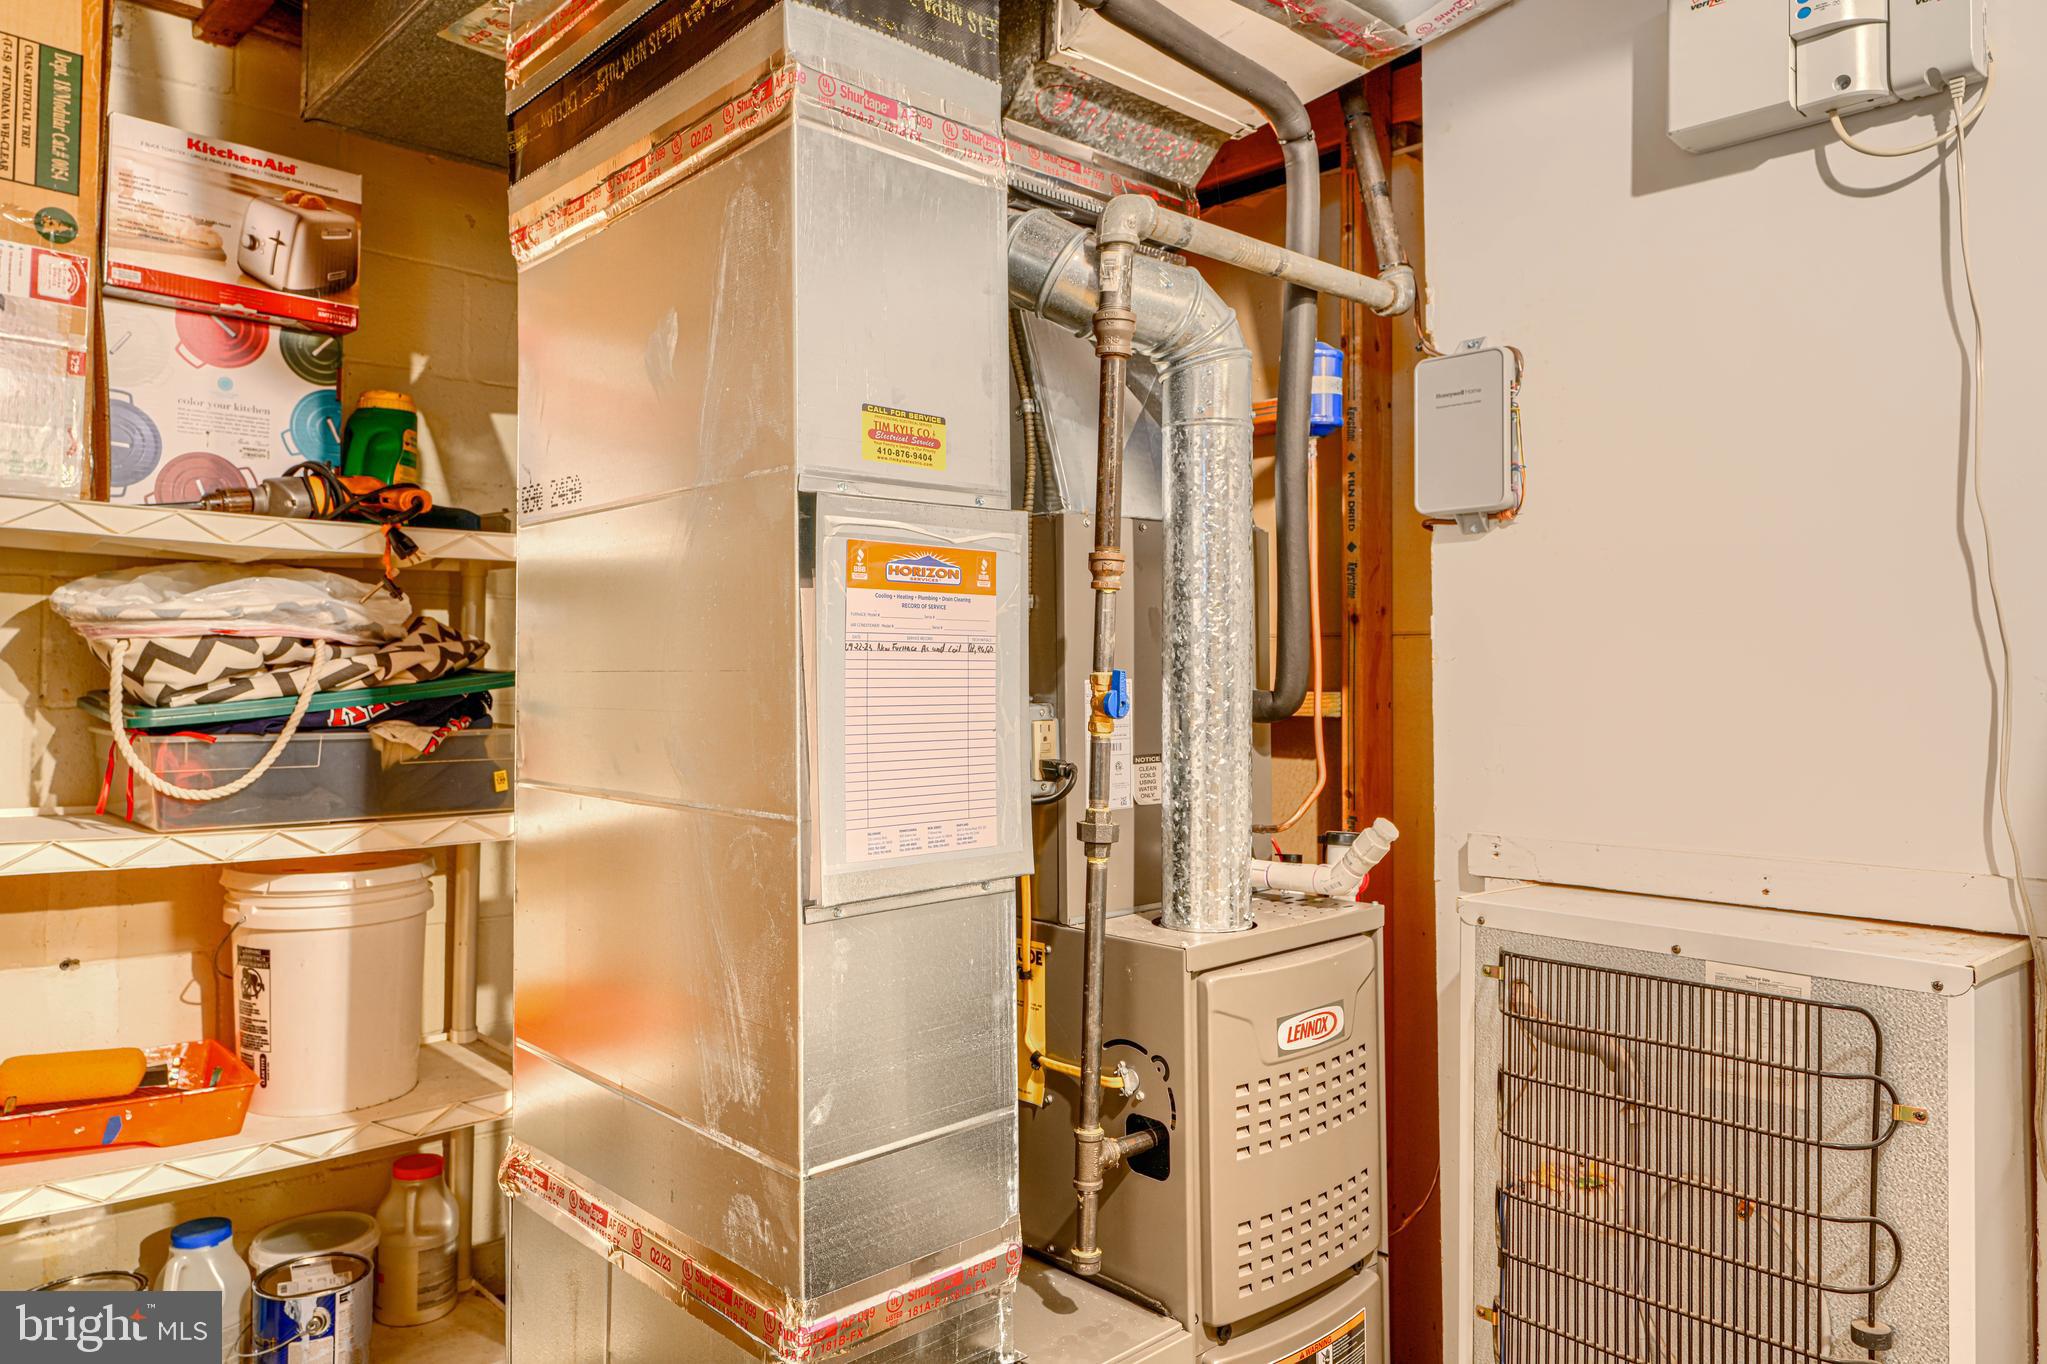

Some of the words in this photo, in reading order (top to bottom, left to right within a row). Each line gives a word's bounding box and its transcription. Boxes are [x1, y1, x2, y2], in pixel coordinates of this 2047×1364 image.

[23, 44, 34, 71] CMAS
[49, 52, 73, 77] Dept.
[2, 65, 12, 83] 4FT
[53, 79, 72, 93] 18
[1, 82, 12, 117] INDIANA
[22, 71, 34, 124] ARTIFICIAL
[839, 83, 891, 114] Shurtape
[918, 114, 932, 130] 099
[52, 90, 71, 132] Modular
[21, 126, 32, 149] TREE
[690, 124, 713, 149] Q2/23
[186, 137, 298, 176] KitchenAid
[50, 158, 70, 182] 0054
[177, 397, 204, 408] color
[207, 400, 233, 411] your
[233, 402, 271, 416] kitchen
[867, 405, 888, 415] CALL
[890, 409, 907, 418] FOR
[908, 412, 942, 424] SERVICE
[873, 420, 891, 432] TIM
[893, 424, 915, 436] KYLE
[875, 430, 910, 443] Electrical
[1347, 471, 1356, 498] KILN
[1347, 500, 1356, 532] DRIED
[888, 565, 960, 580] HORIZON
[918, 594, 939, 602] Plumbing
[892, 642, 917, 652] Furnace
[1287, 1016, 1329, 1044] LENNOX
[617, 1222, 628, 1239] 099
[650, 1247, 672, 1273] Q2/23
[695, 1269, 727, 1300] Shurtape
[733, 1293, 743, 1309] AF
[744, 1302, 757, 1320] 099
[965, 1264, 980, 1280] AF
[980, 1257, 997, 1274] 099
[885, 1311, 903, 1323] LISTED
[907, 1297, 941, 1318] 181A-P
[820, 1330, 864, 1355] 181B-FX
[1305, 1335, 1332, 1357] WARNING
